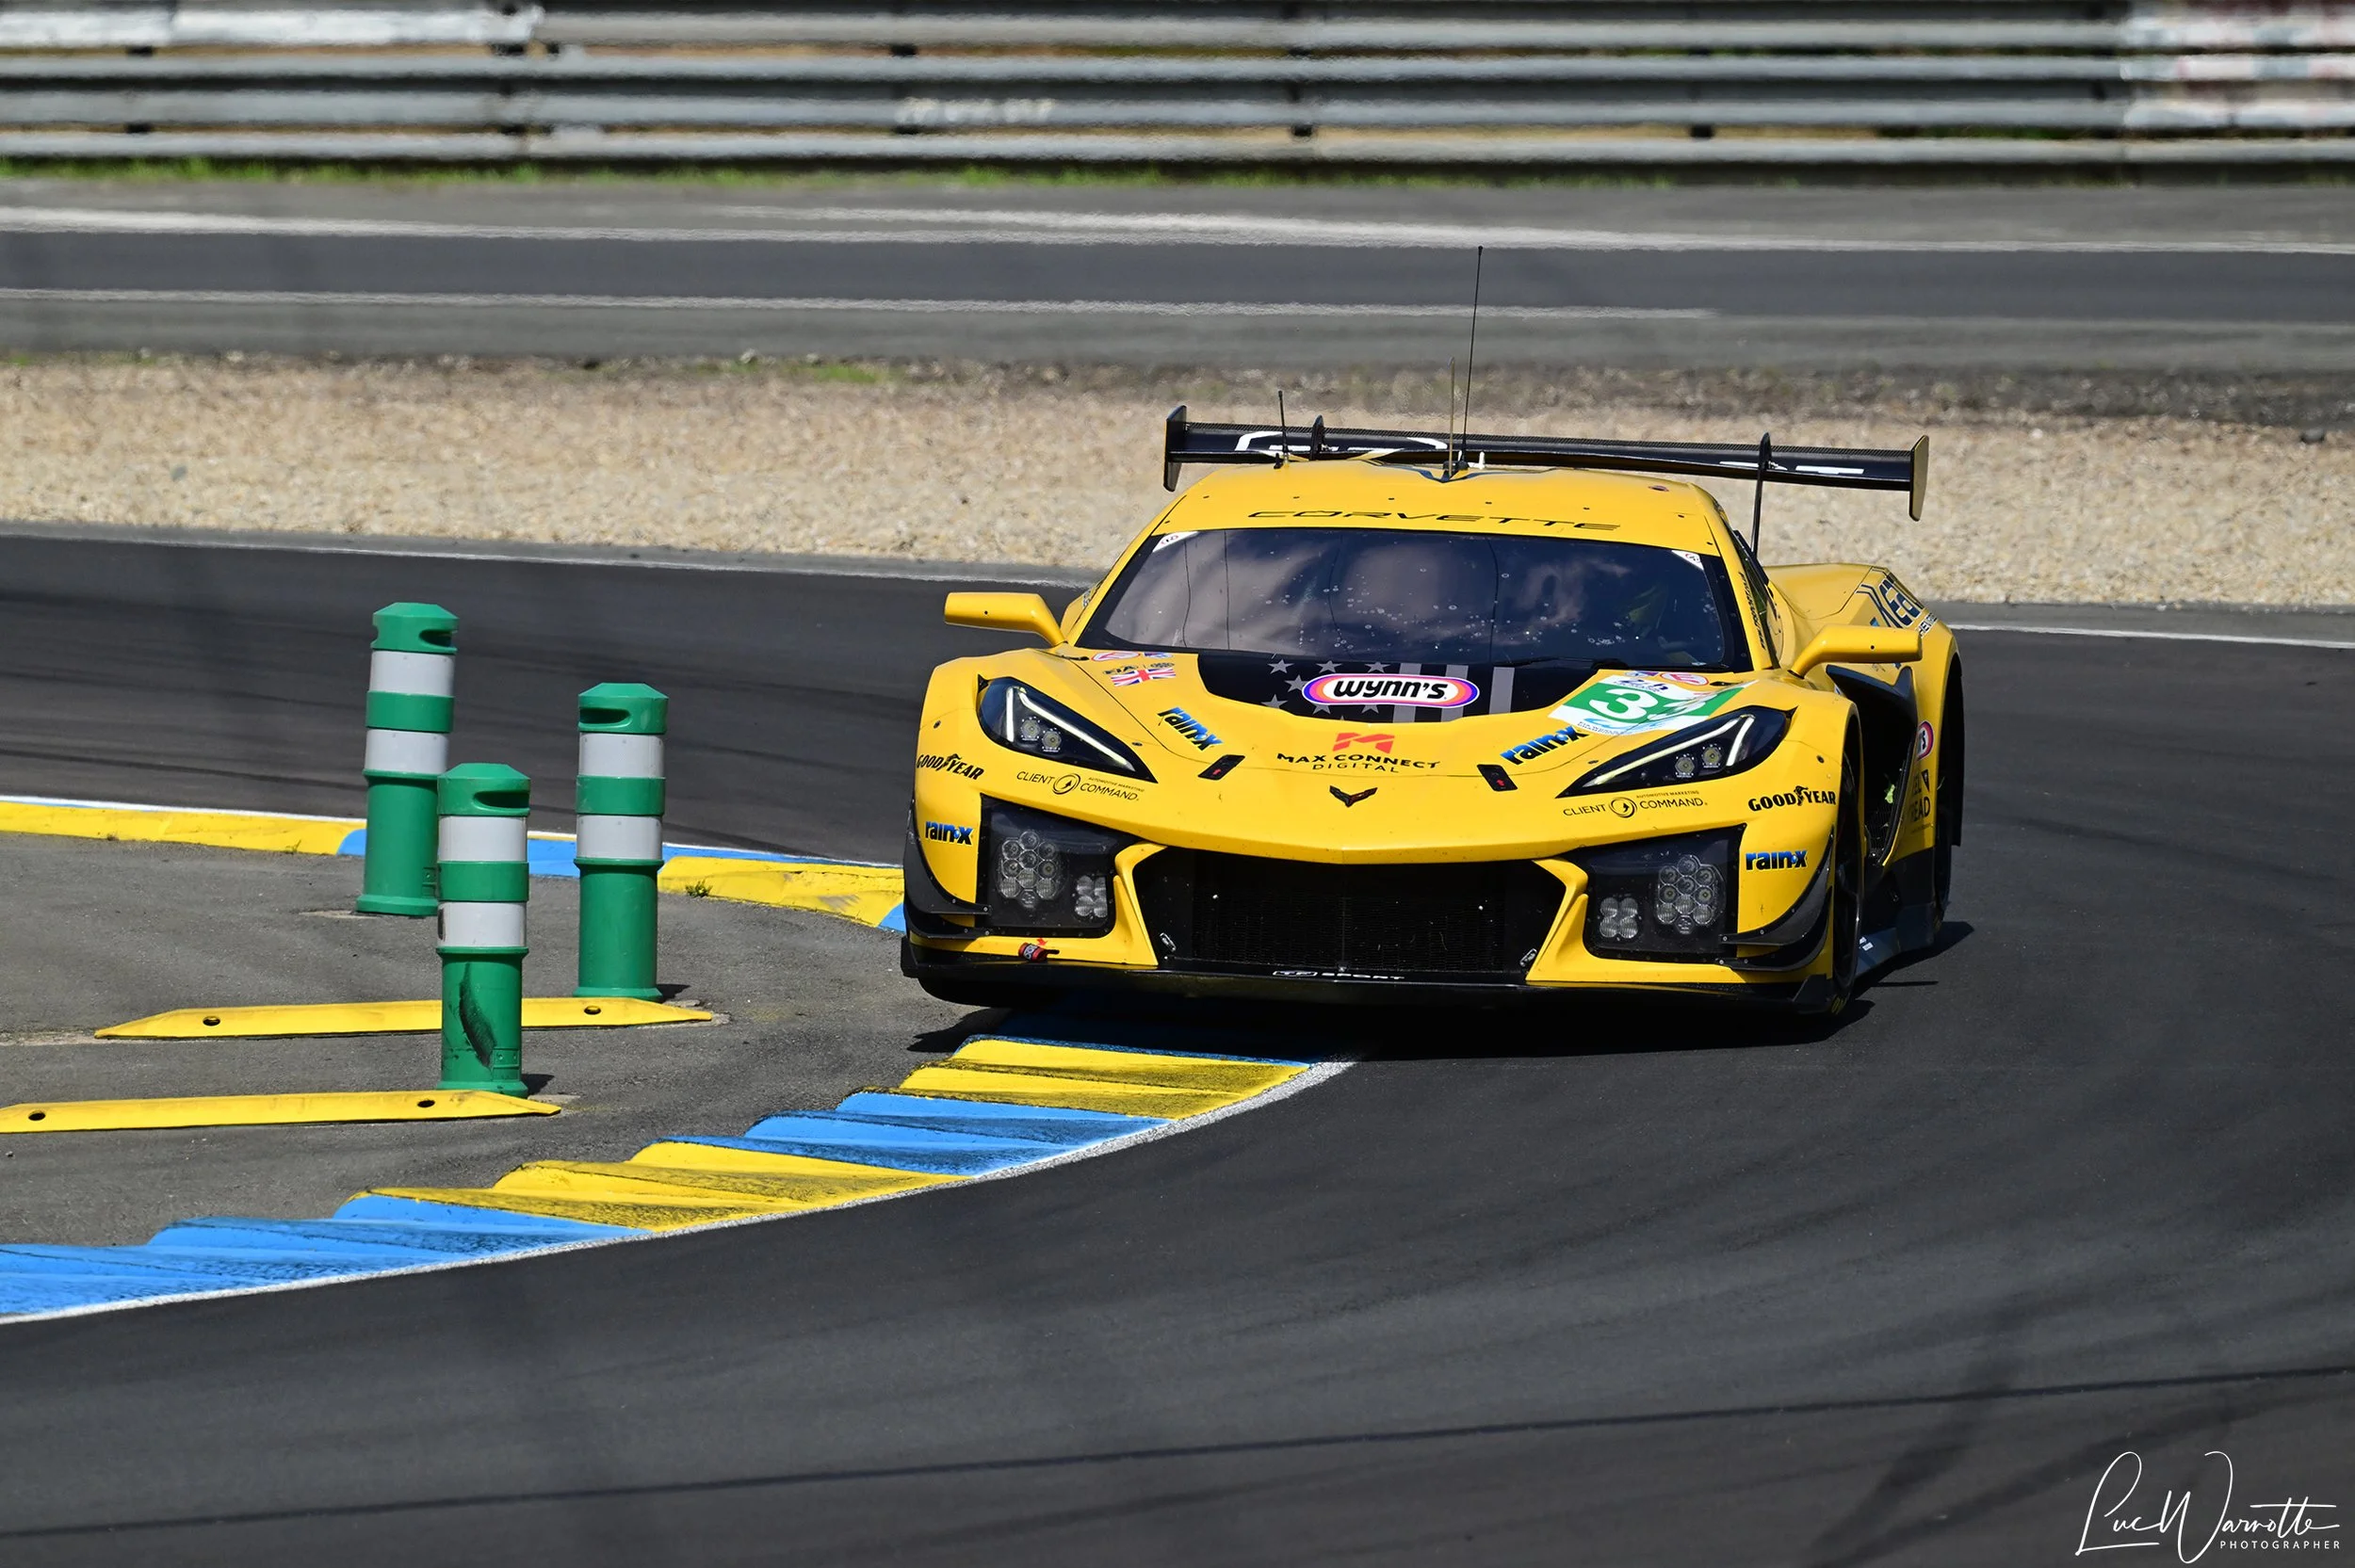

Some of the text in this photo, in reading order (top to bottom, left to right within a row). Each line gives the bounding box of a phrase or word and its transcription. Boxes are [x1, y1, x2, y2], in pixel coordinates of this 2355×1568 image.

[1247, 509, 1621, 531] CORVETTE
[1276, 752, 1441, 768] MAX CONNECT
[1312, 762, 1400, 773] DIGITAL
[1016, 770, 1138, 801] CLIENT COMMAND
[1563, 797, 1704, 816] CLIENT COMMAND
